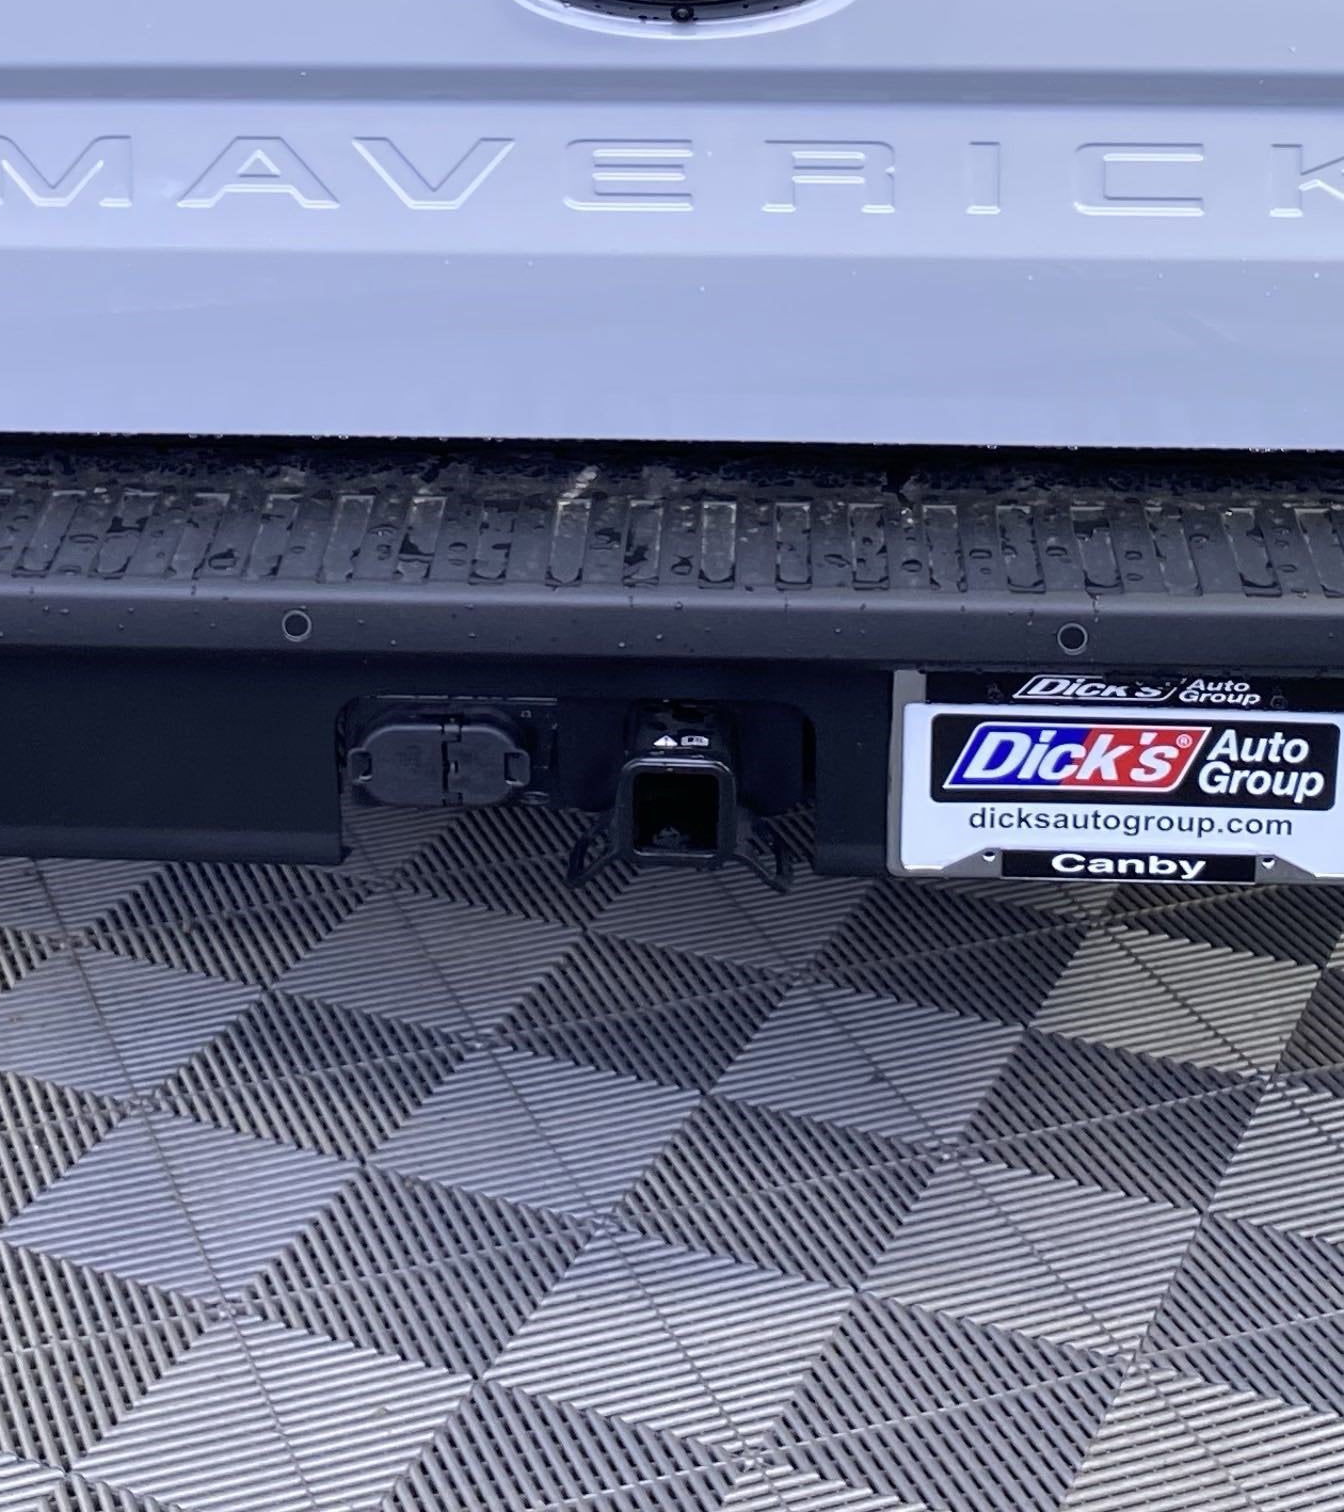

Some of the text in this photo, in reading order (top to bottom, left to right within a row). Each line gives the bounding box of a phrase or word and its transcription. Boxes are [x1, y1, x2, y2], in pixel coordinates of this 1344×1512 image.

[1026, 677, 1162, 698] Dicks
[1179, 690, 1261, 706] Group
[1186, 678, 1250, 692] Auto
[1207, 729, 1309, 763] Auto
[1198, 761, 1325, 803] Group
[969, 808, 1293, 838] dicksautogroup.com
[1051, 853, 1206, 879] Canby
